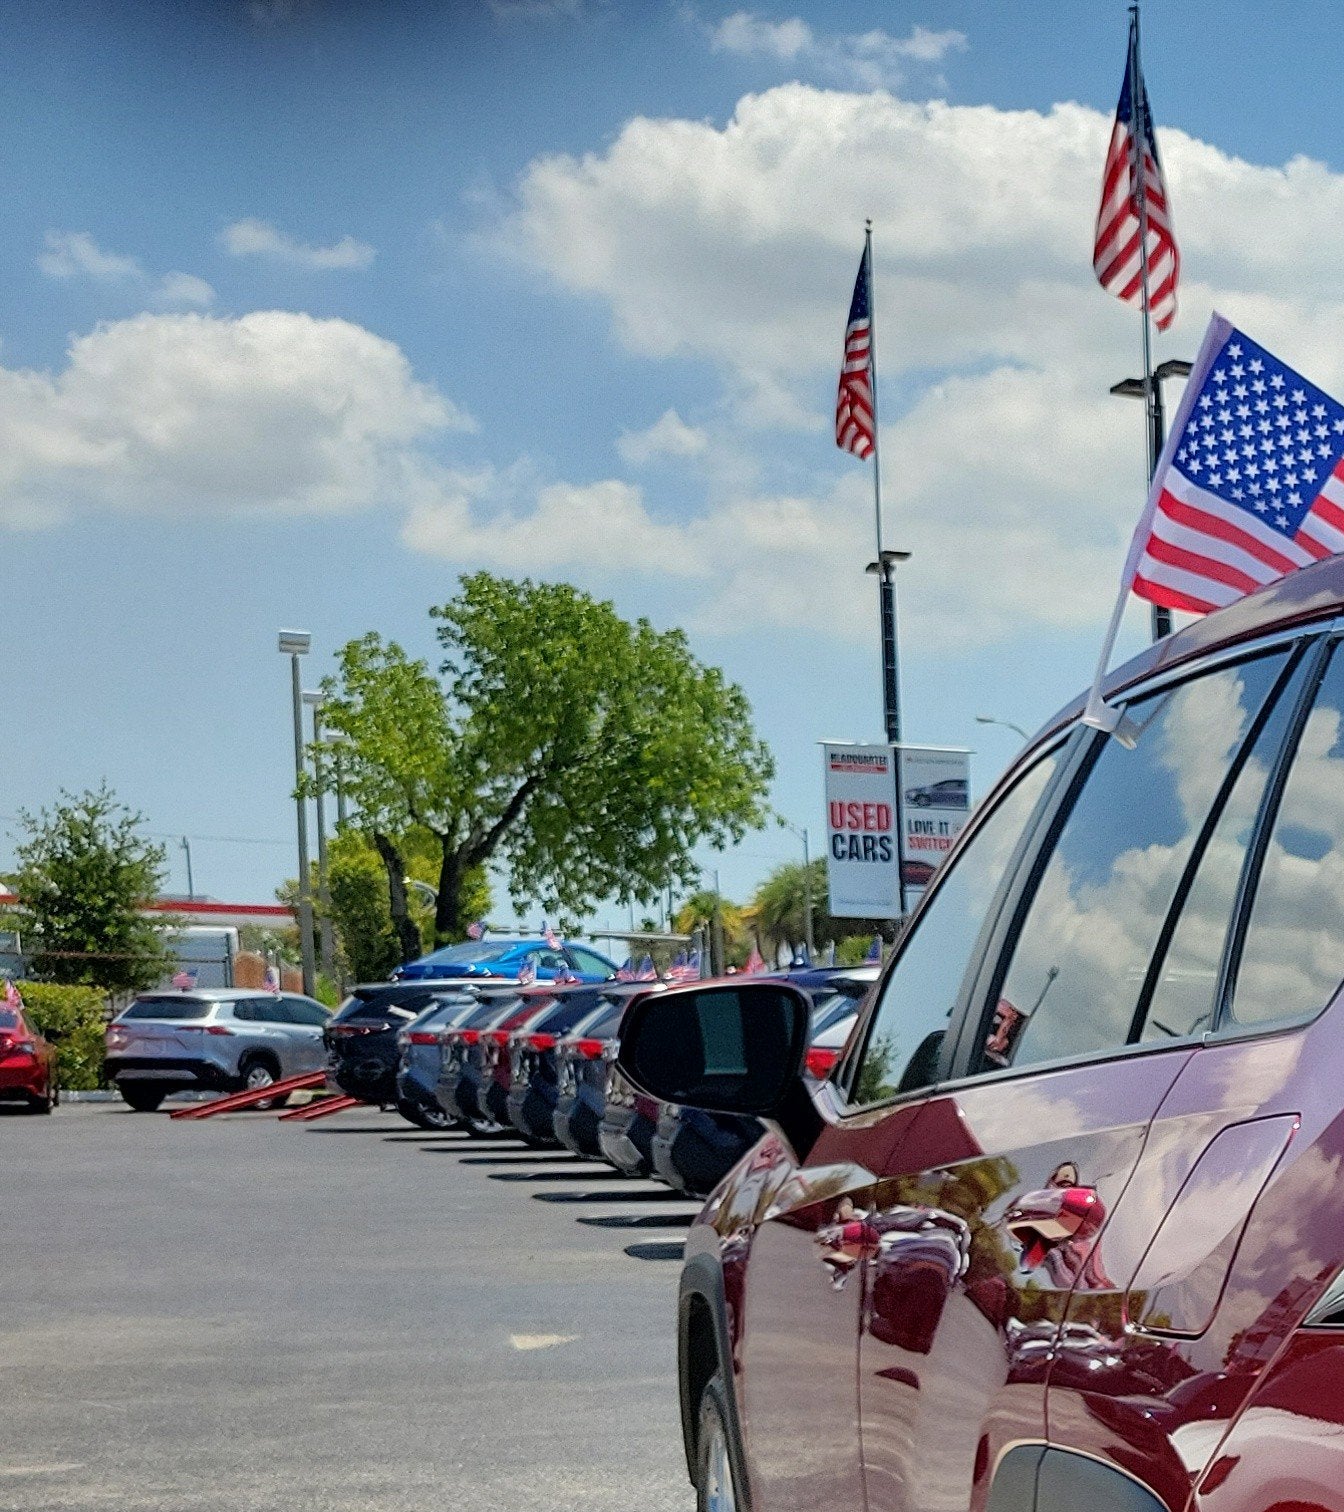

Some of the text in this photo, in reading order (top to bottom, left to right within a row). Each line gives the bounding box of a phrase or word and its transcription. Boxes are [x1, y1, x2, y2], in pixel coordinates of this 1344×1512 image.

[830, 801, 892, 832] USED
[908, 819, 935, 835] LOVE
[939, 820, 949, 836] IT
[832, 833, 893, 863] CARS
